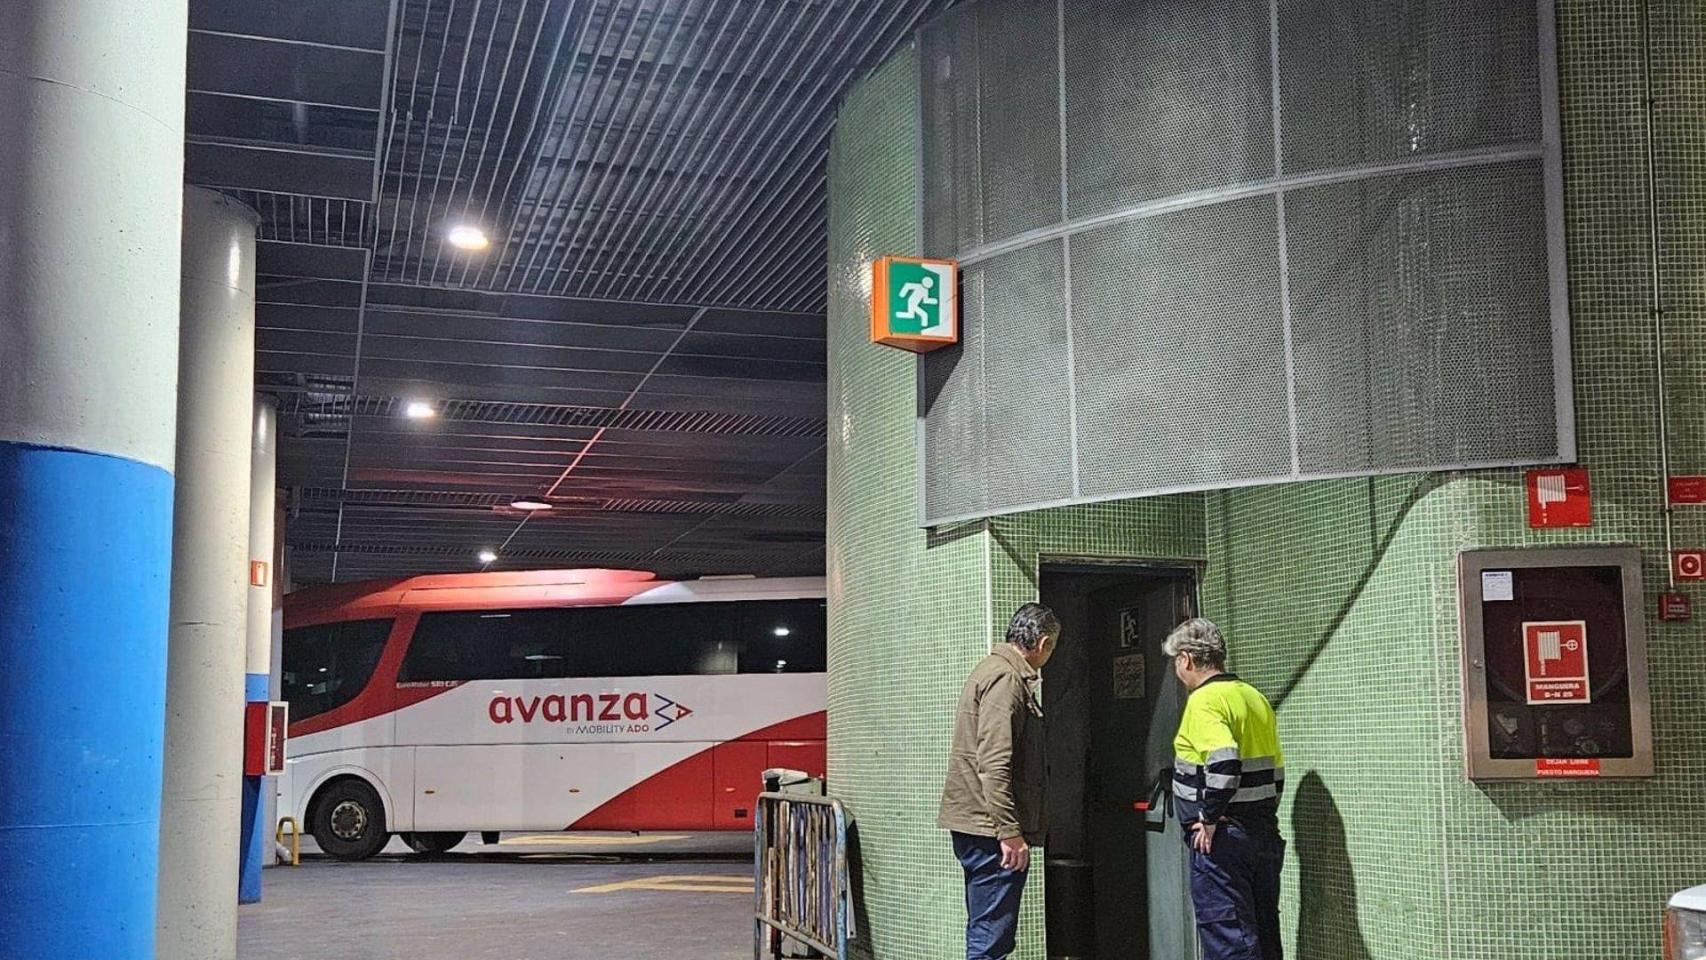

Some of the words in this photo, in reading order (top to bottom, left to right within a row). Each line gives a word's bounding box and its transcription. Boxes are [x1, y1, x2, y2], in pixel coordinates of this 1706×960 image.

[1535, 682, 1580, 690] MANGUERA
[488, 692, 649, 724] avanza
[575, 724, 625, 734] MOBILITY
[626, 723, 650, 733] ADO
